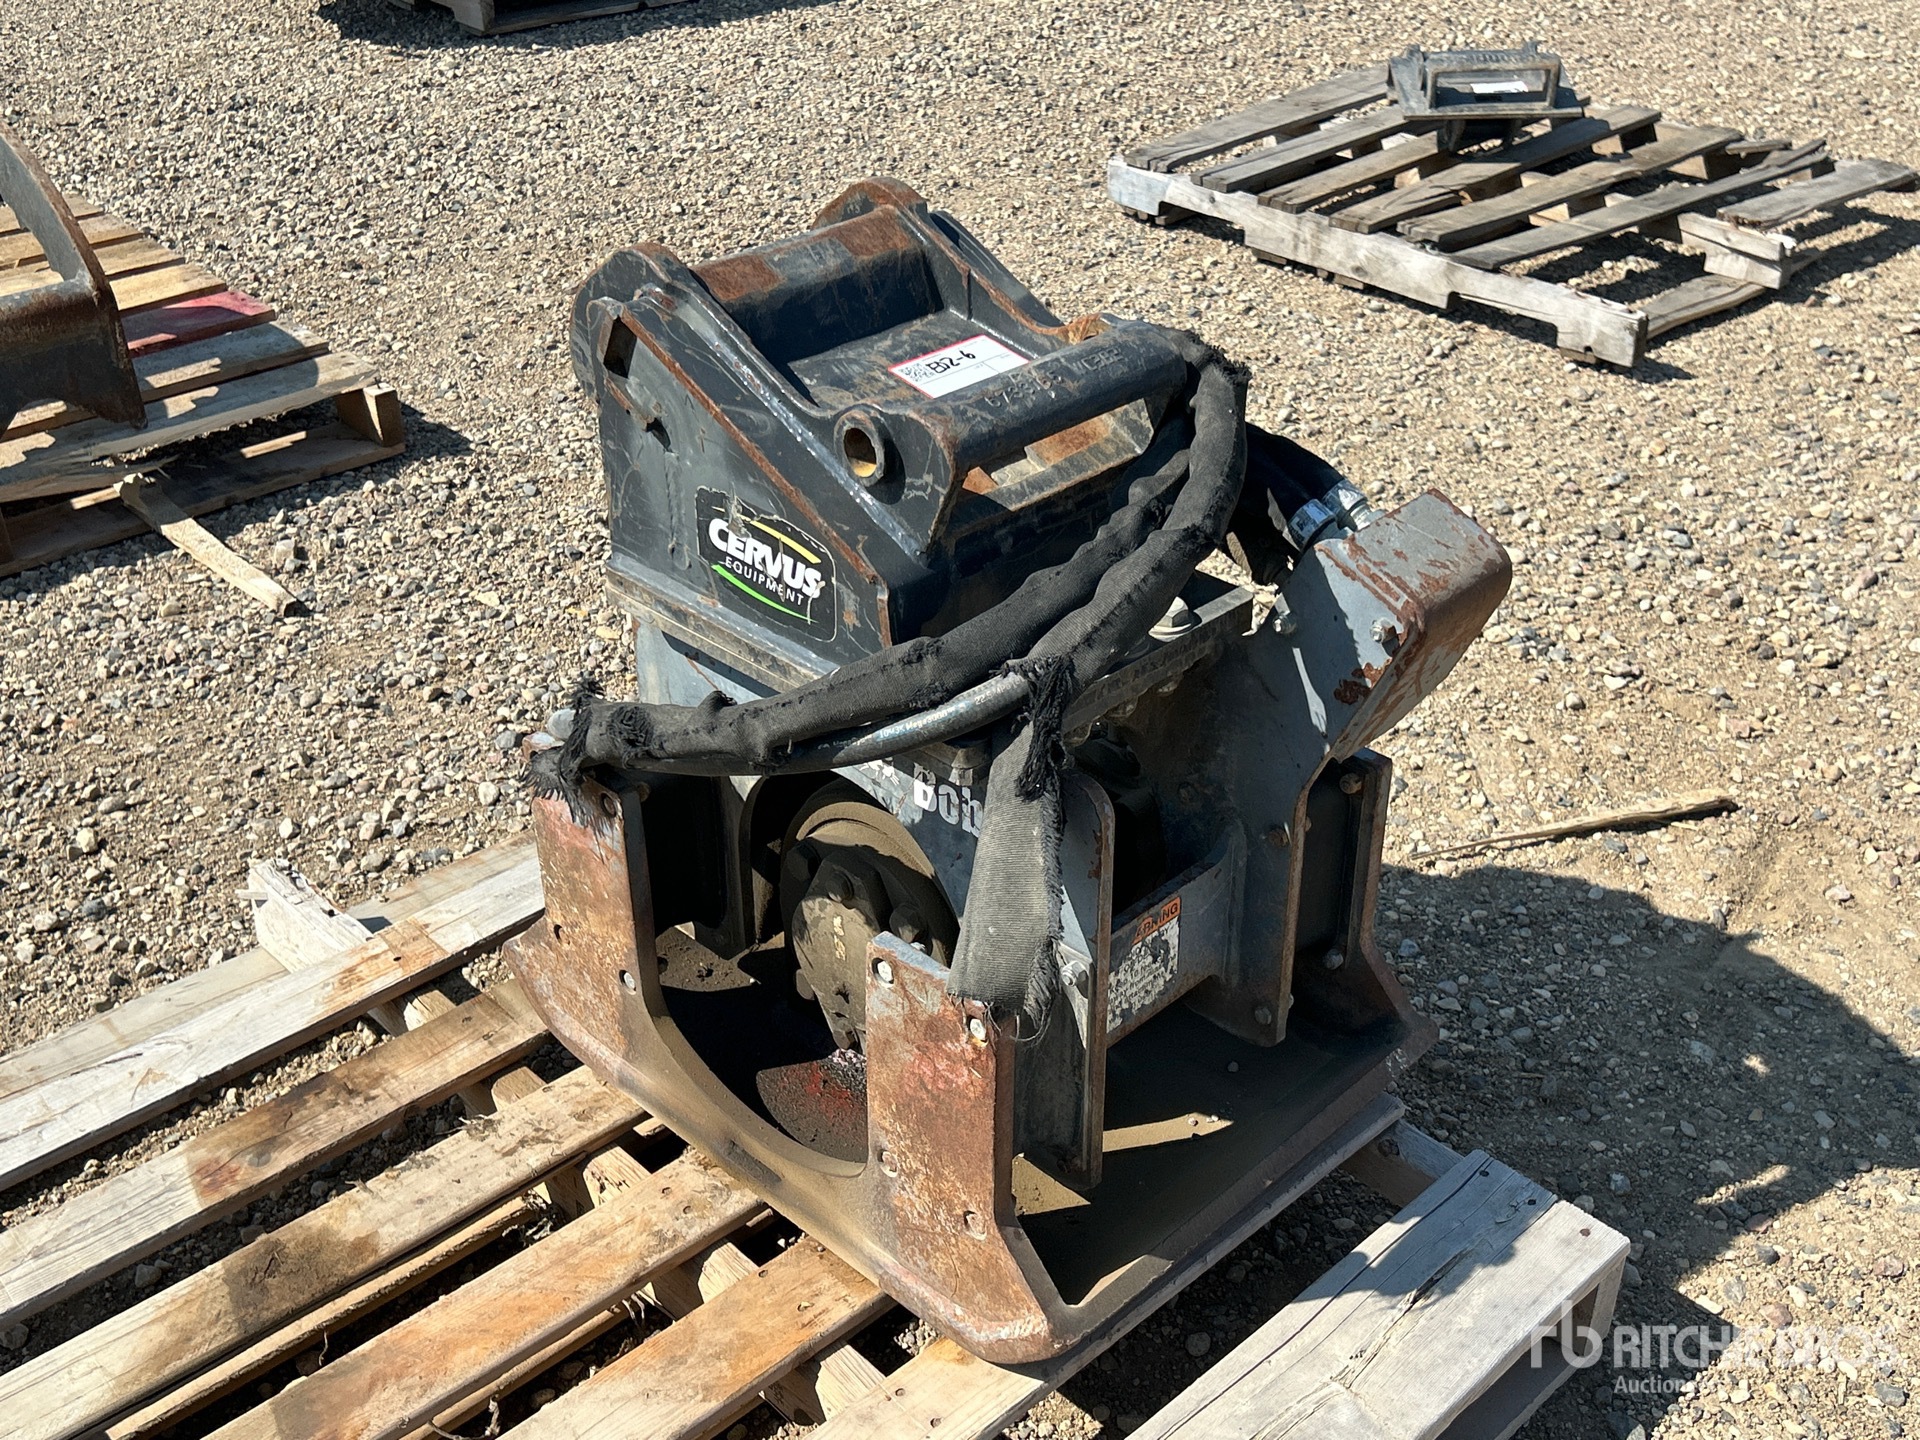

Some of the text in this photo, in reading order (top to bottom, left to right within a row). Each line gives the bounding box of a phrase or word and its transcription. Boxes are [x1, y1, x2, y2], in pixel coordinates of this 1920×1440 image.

[708, 518, 822, 599] CERVUS
[724, 556, 805, 605] EQUIPMENT
[913, 762, 984, 839] Bob
